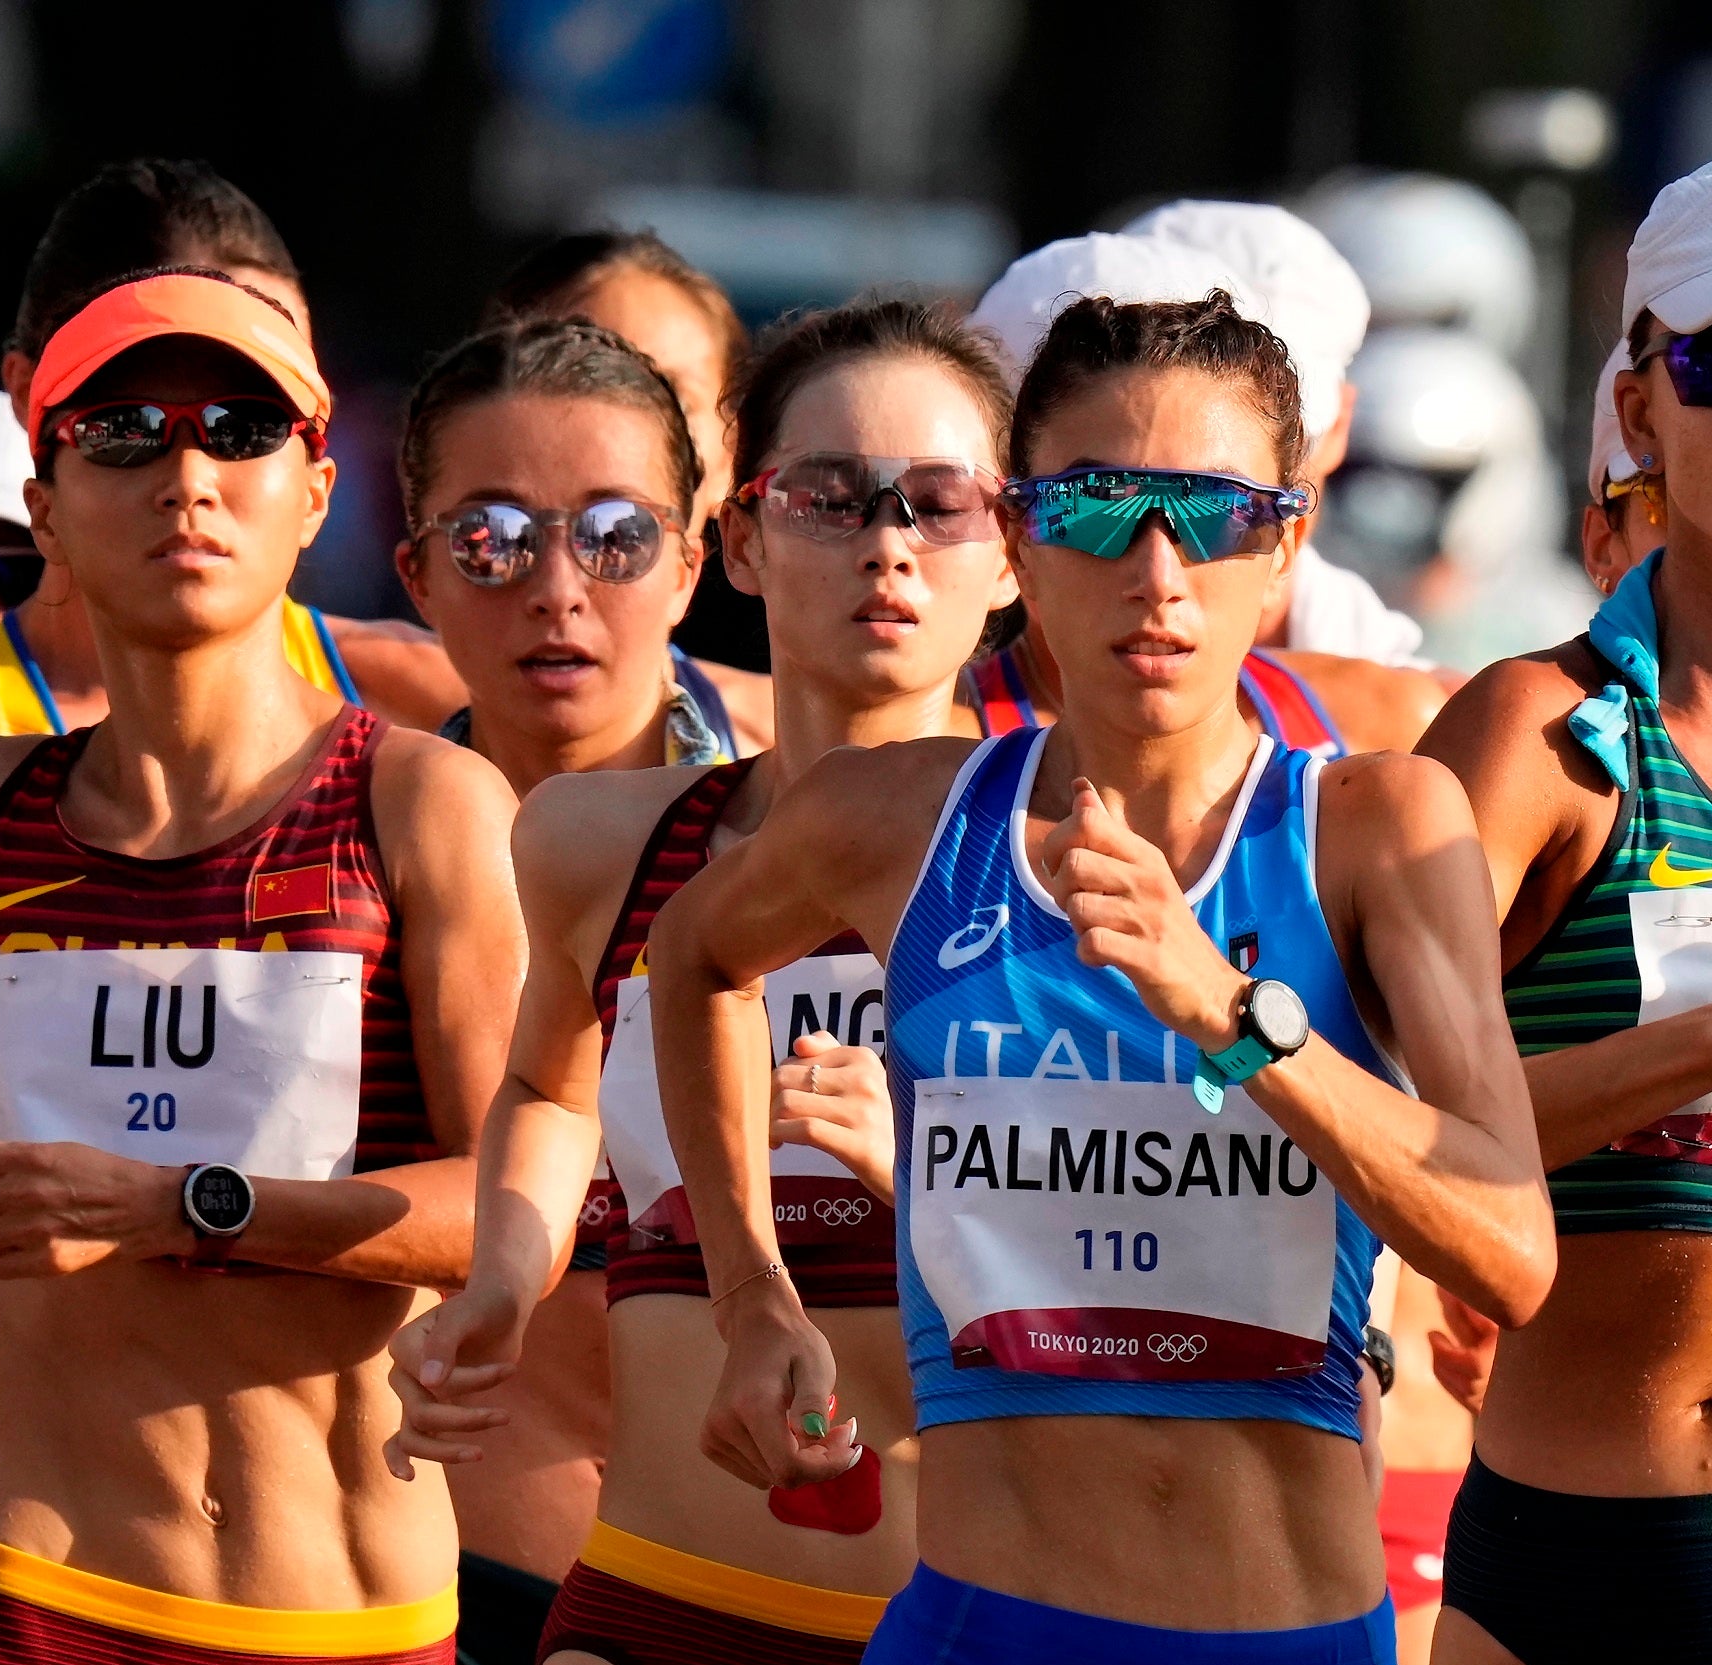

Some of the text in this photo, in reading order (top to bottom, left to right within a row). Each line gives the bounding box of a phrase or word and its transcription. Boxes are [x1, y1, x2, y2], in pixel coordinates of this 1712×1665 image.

[90, 984, 217, 1070] LIU
[762, 989, 887, 1070] NG
[126, 1092, 177, 1132] 20
[925, 1124, 1318, 1198] PALMISANO
[774, 1204, 807, 1222] 020
[1074, 1228, 1159, 1272] 110
[1027, 1331, 1139, 1356] TOKYO 2020
